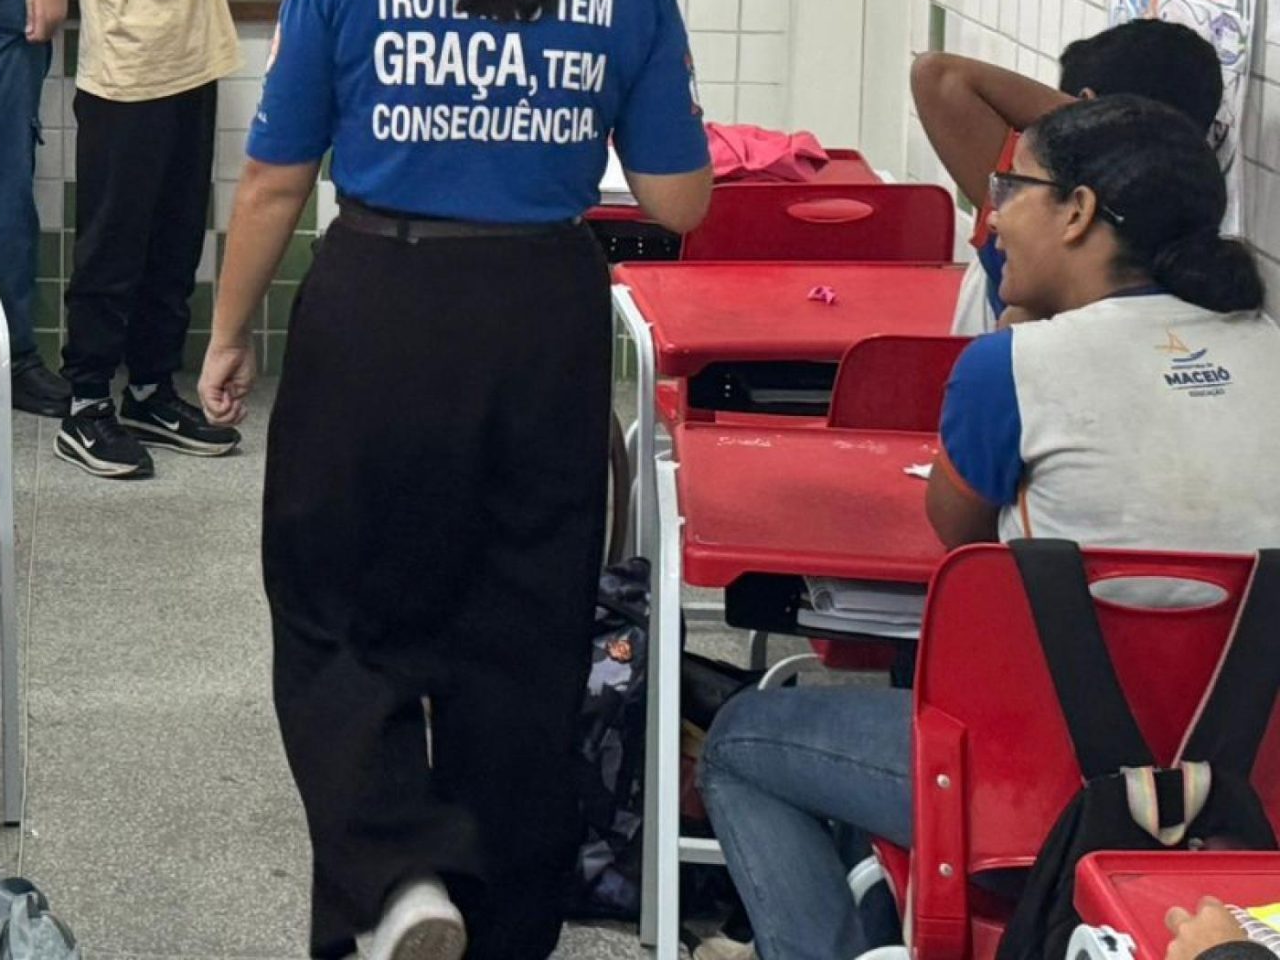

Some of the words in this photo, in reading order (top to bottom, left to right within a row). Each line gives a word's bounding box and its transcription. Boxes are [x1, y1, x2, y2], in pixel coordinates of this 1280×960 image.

[373, 30, 538, 101] GRAÇA,
[542, 48, 607, 93] TEM
[372, 98, 599, 144] CONSEQUÊNCIA.
[1164, 366, 1231, 386] MACEIÓ
